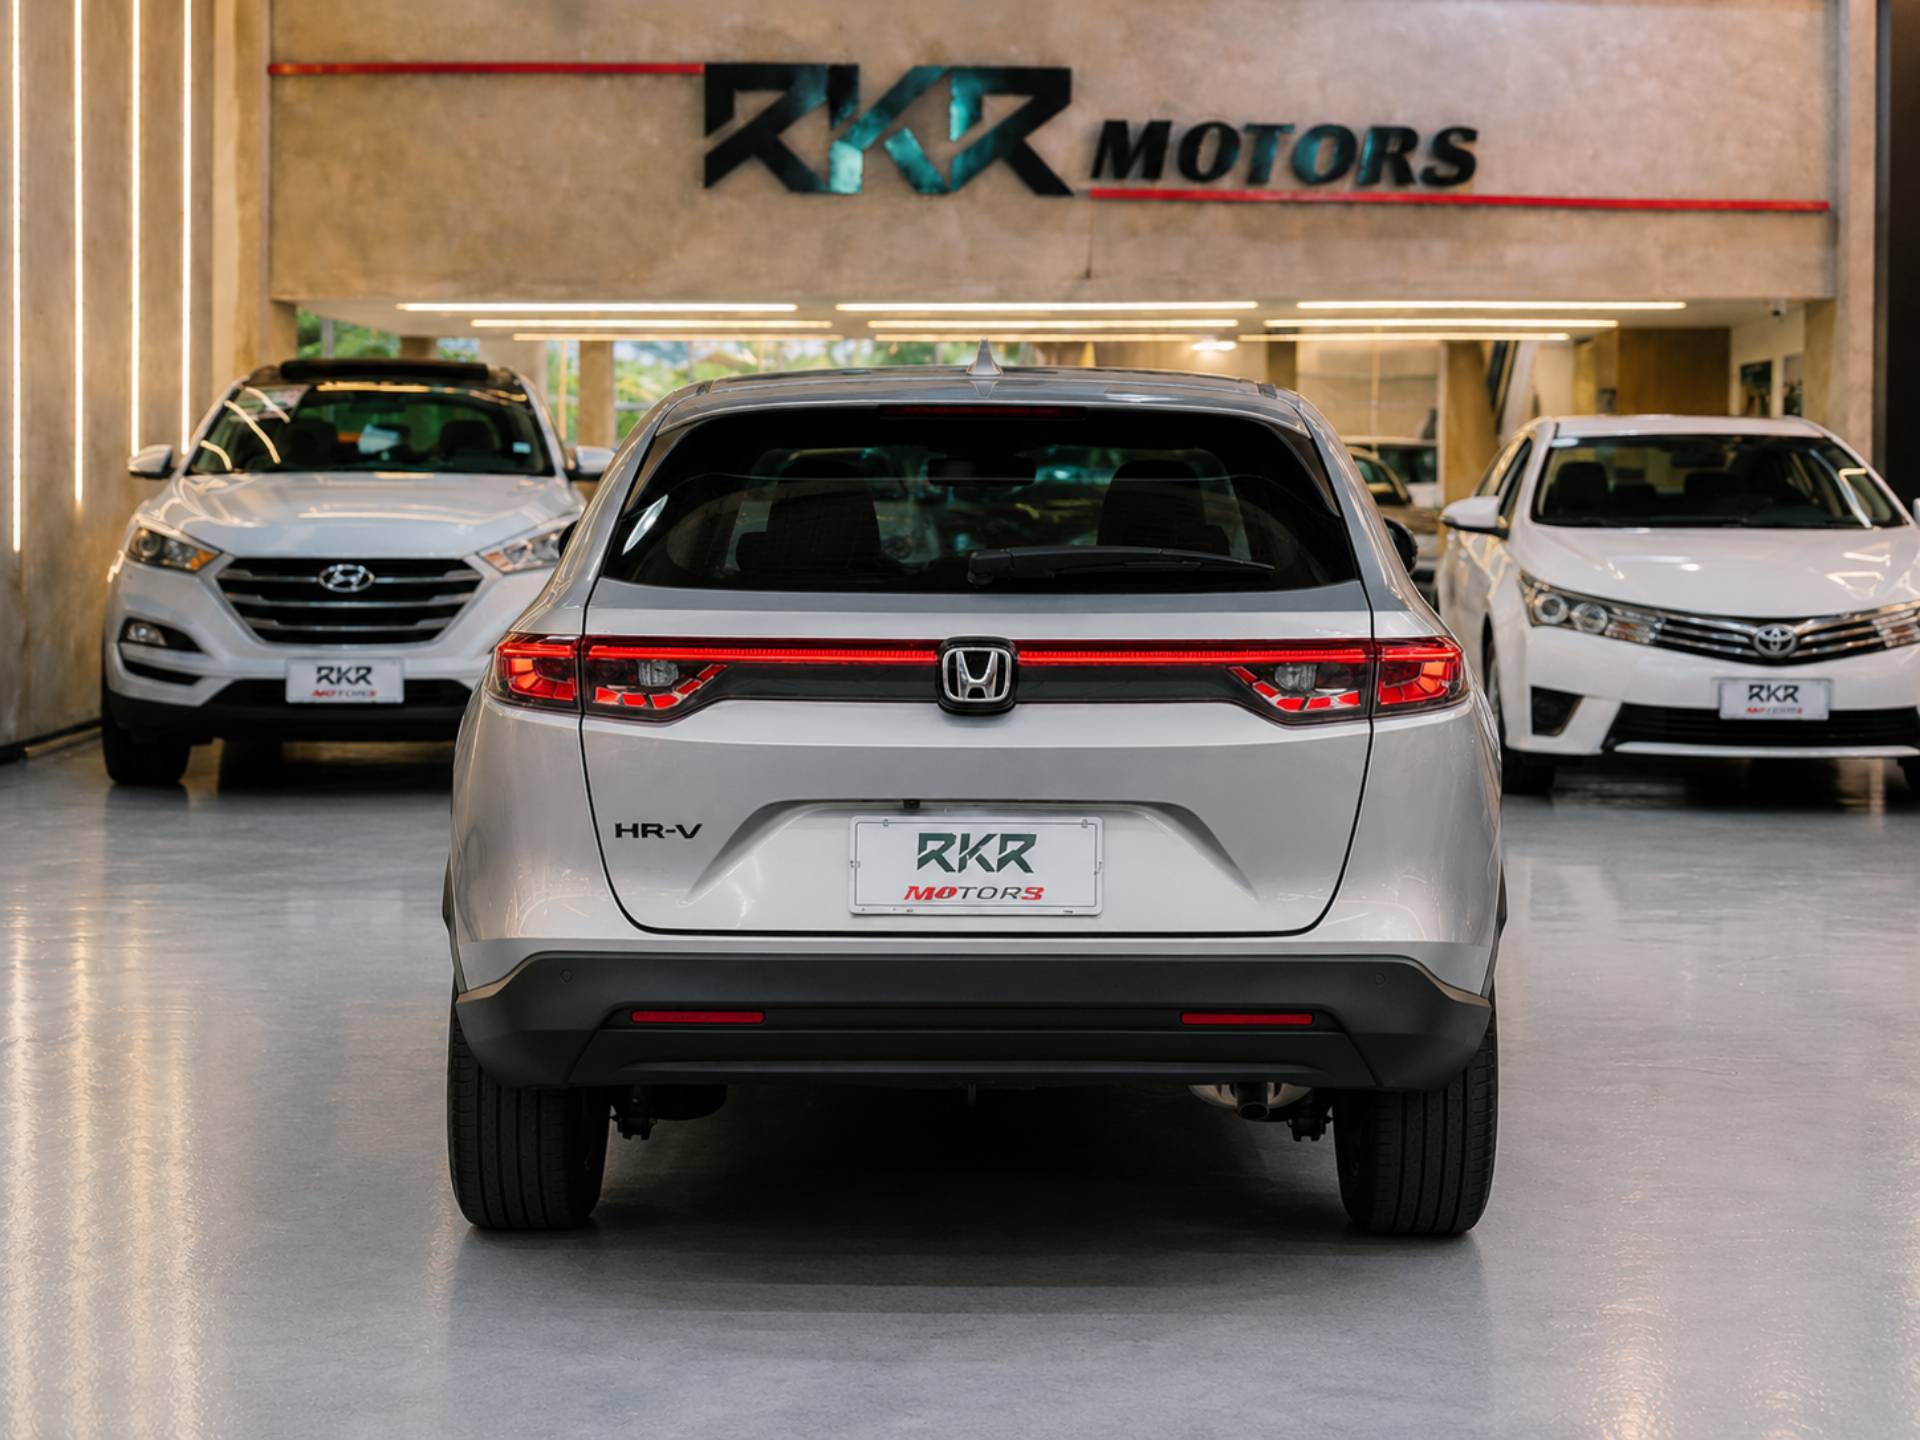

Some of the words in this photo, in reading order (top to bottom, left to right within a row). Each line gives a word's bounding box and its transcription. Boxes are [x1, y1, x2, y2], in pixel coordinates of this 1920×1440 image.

[703, 62, 1073, 196] RKR
[1090, 119, 1479, 188] MOTORS
[316, 665, 372, 685] RKR
[1748, 684, 1799, 703] RKR
[614, 822, 703, 839] HR-V
[916, 832, 1037, 874] RKR
